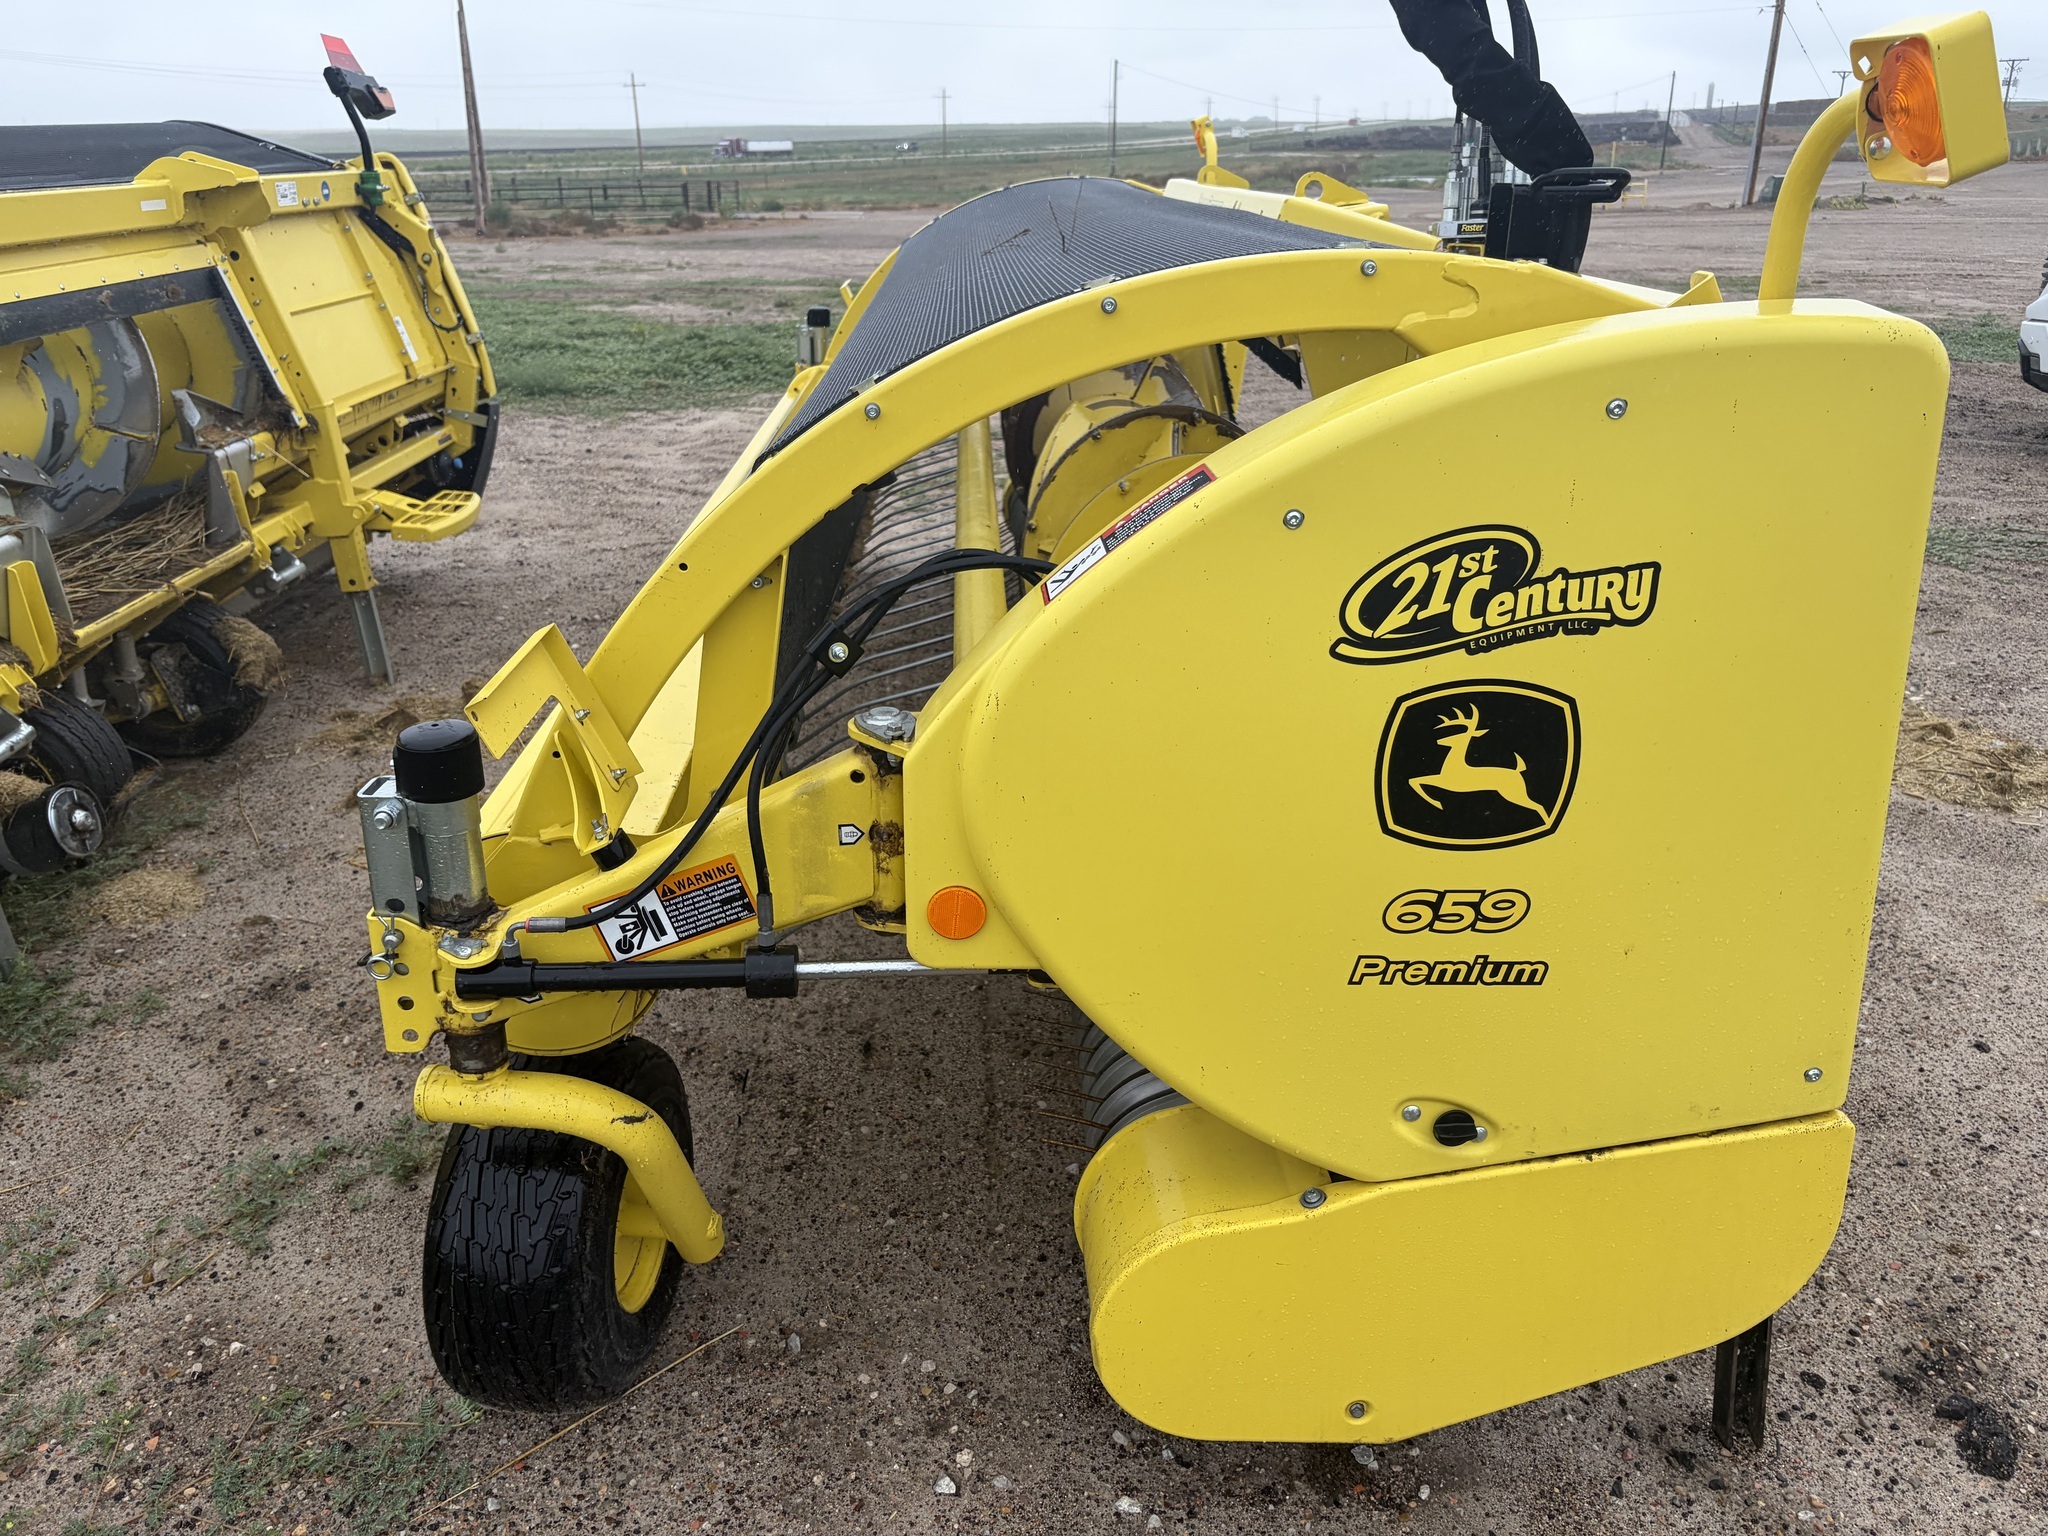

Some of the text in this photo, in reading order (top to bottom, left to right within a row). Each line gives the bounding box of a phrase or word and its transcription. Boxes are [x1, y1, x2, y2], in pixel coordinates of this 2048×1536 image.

[1461, 224, 1484, 232] Faster
[1131, 476, 1188, 516] DANGER
[1373, 545, 1499, 638] 21st
[1470, 620, 1594, 649] EQUIPMENT LLC.
[673, 862, 736, 892] WARNING
[1382, 889, 1531, 934] 659
[1347, 955, 1549, 985] Premium
